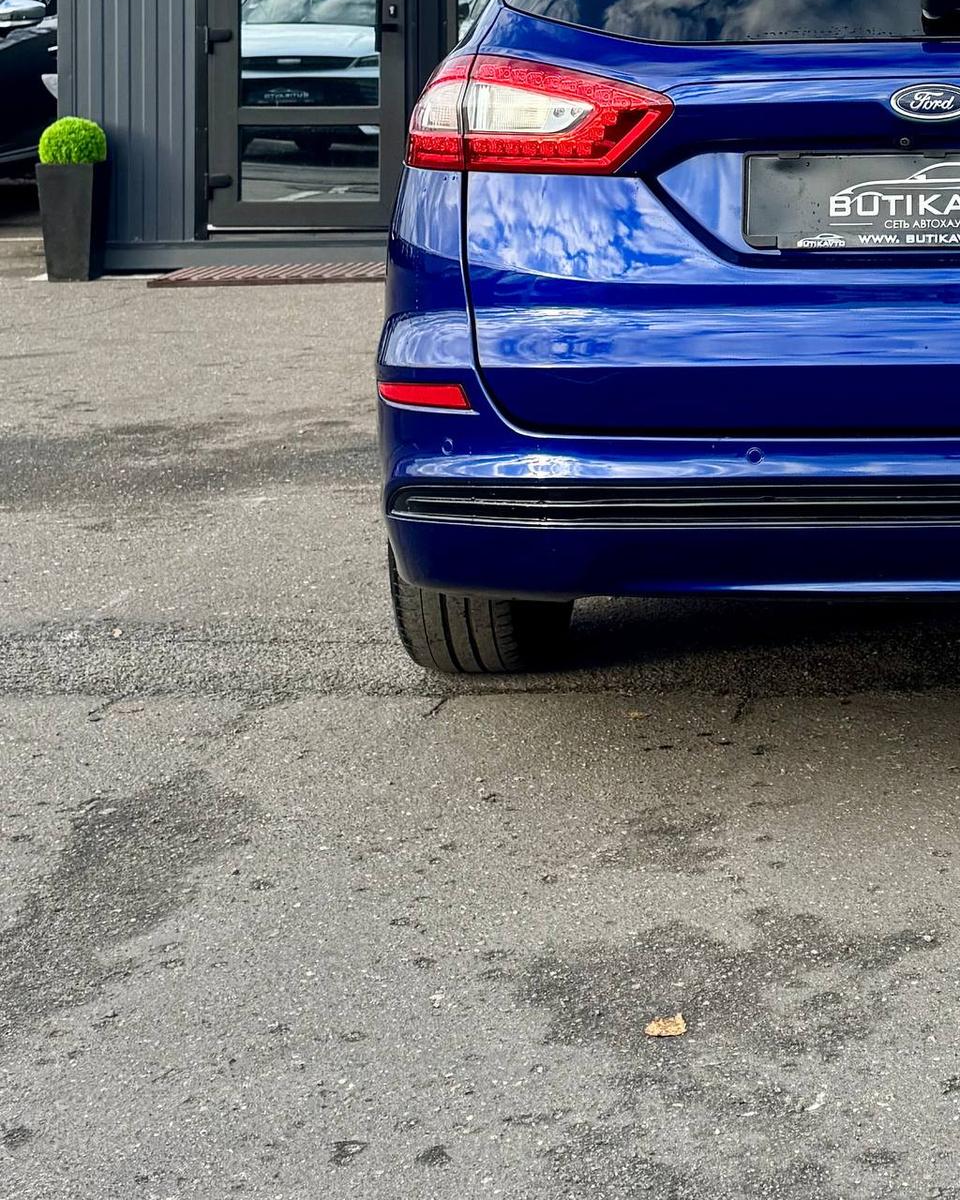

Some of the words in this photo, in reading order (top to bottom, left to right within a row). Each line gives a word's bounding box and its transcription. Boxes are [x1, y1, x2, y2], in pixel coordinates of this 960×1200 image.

[909, 91, 955, 111] Ford
[884, 219, 910, 229] СЕТЬ
[797, 239, 846, 248] BUTIKAVTO
[858, 234, 900, 244] WWW.
